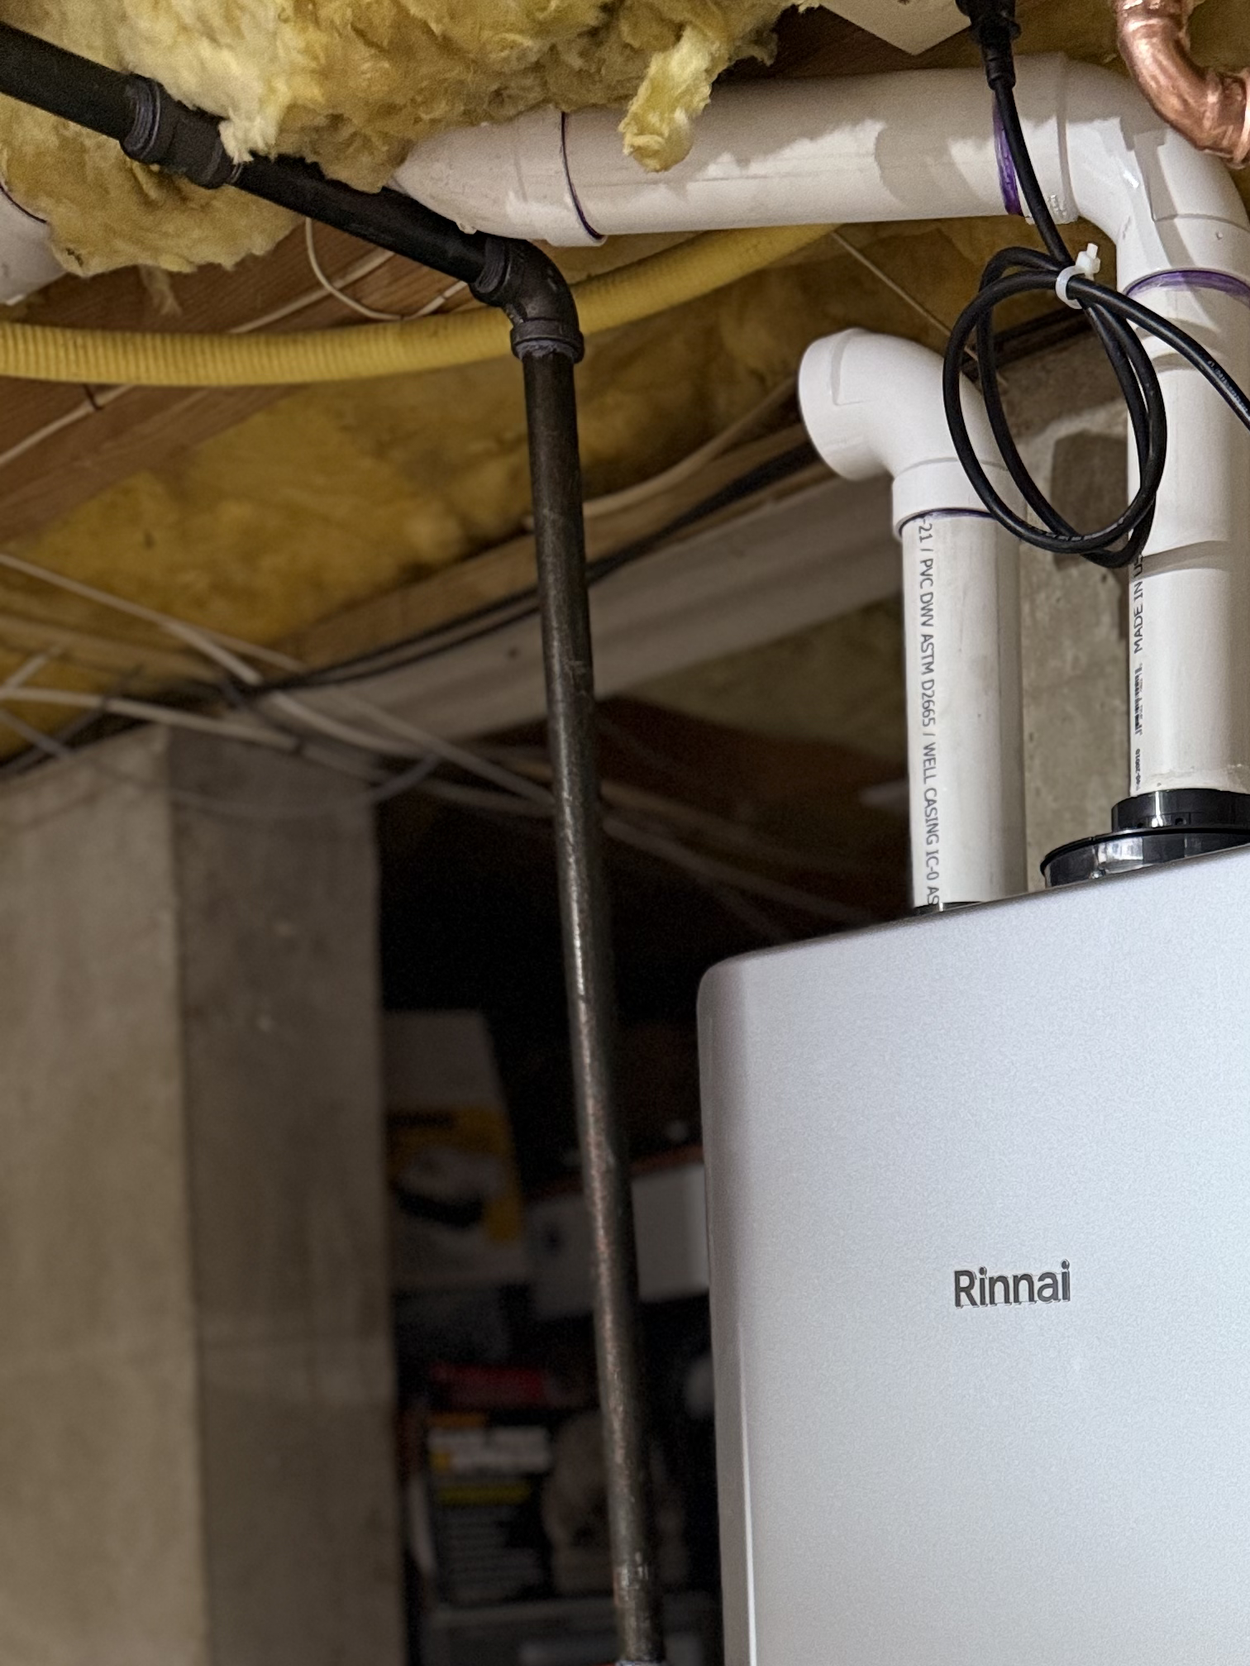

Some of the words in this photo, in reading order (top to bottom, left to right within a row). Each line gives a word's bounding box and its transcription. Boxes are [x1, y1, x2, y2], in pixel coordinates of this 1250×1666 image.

[920, 558, 934, 590] PVC
[1133, 581, 1143, 601] IN
[920, 591, 934, 627] DWV
[1133, 604, 1143, 654] MADE
[921, 633, 935, 675] ASTM
[921, 679, 936, 727] D2665
[923, 741, 937, 785] WELL
[924, 788, 940, 845] CASING
[954, 1259, 1071, 1308] Rinnai
